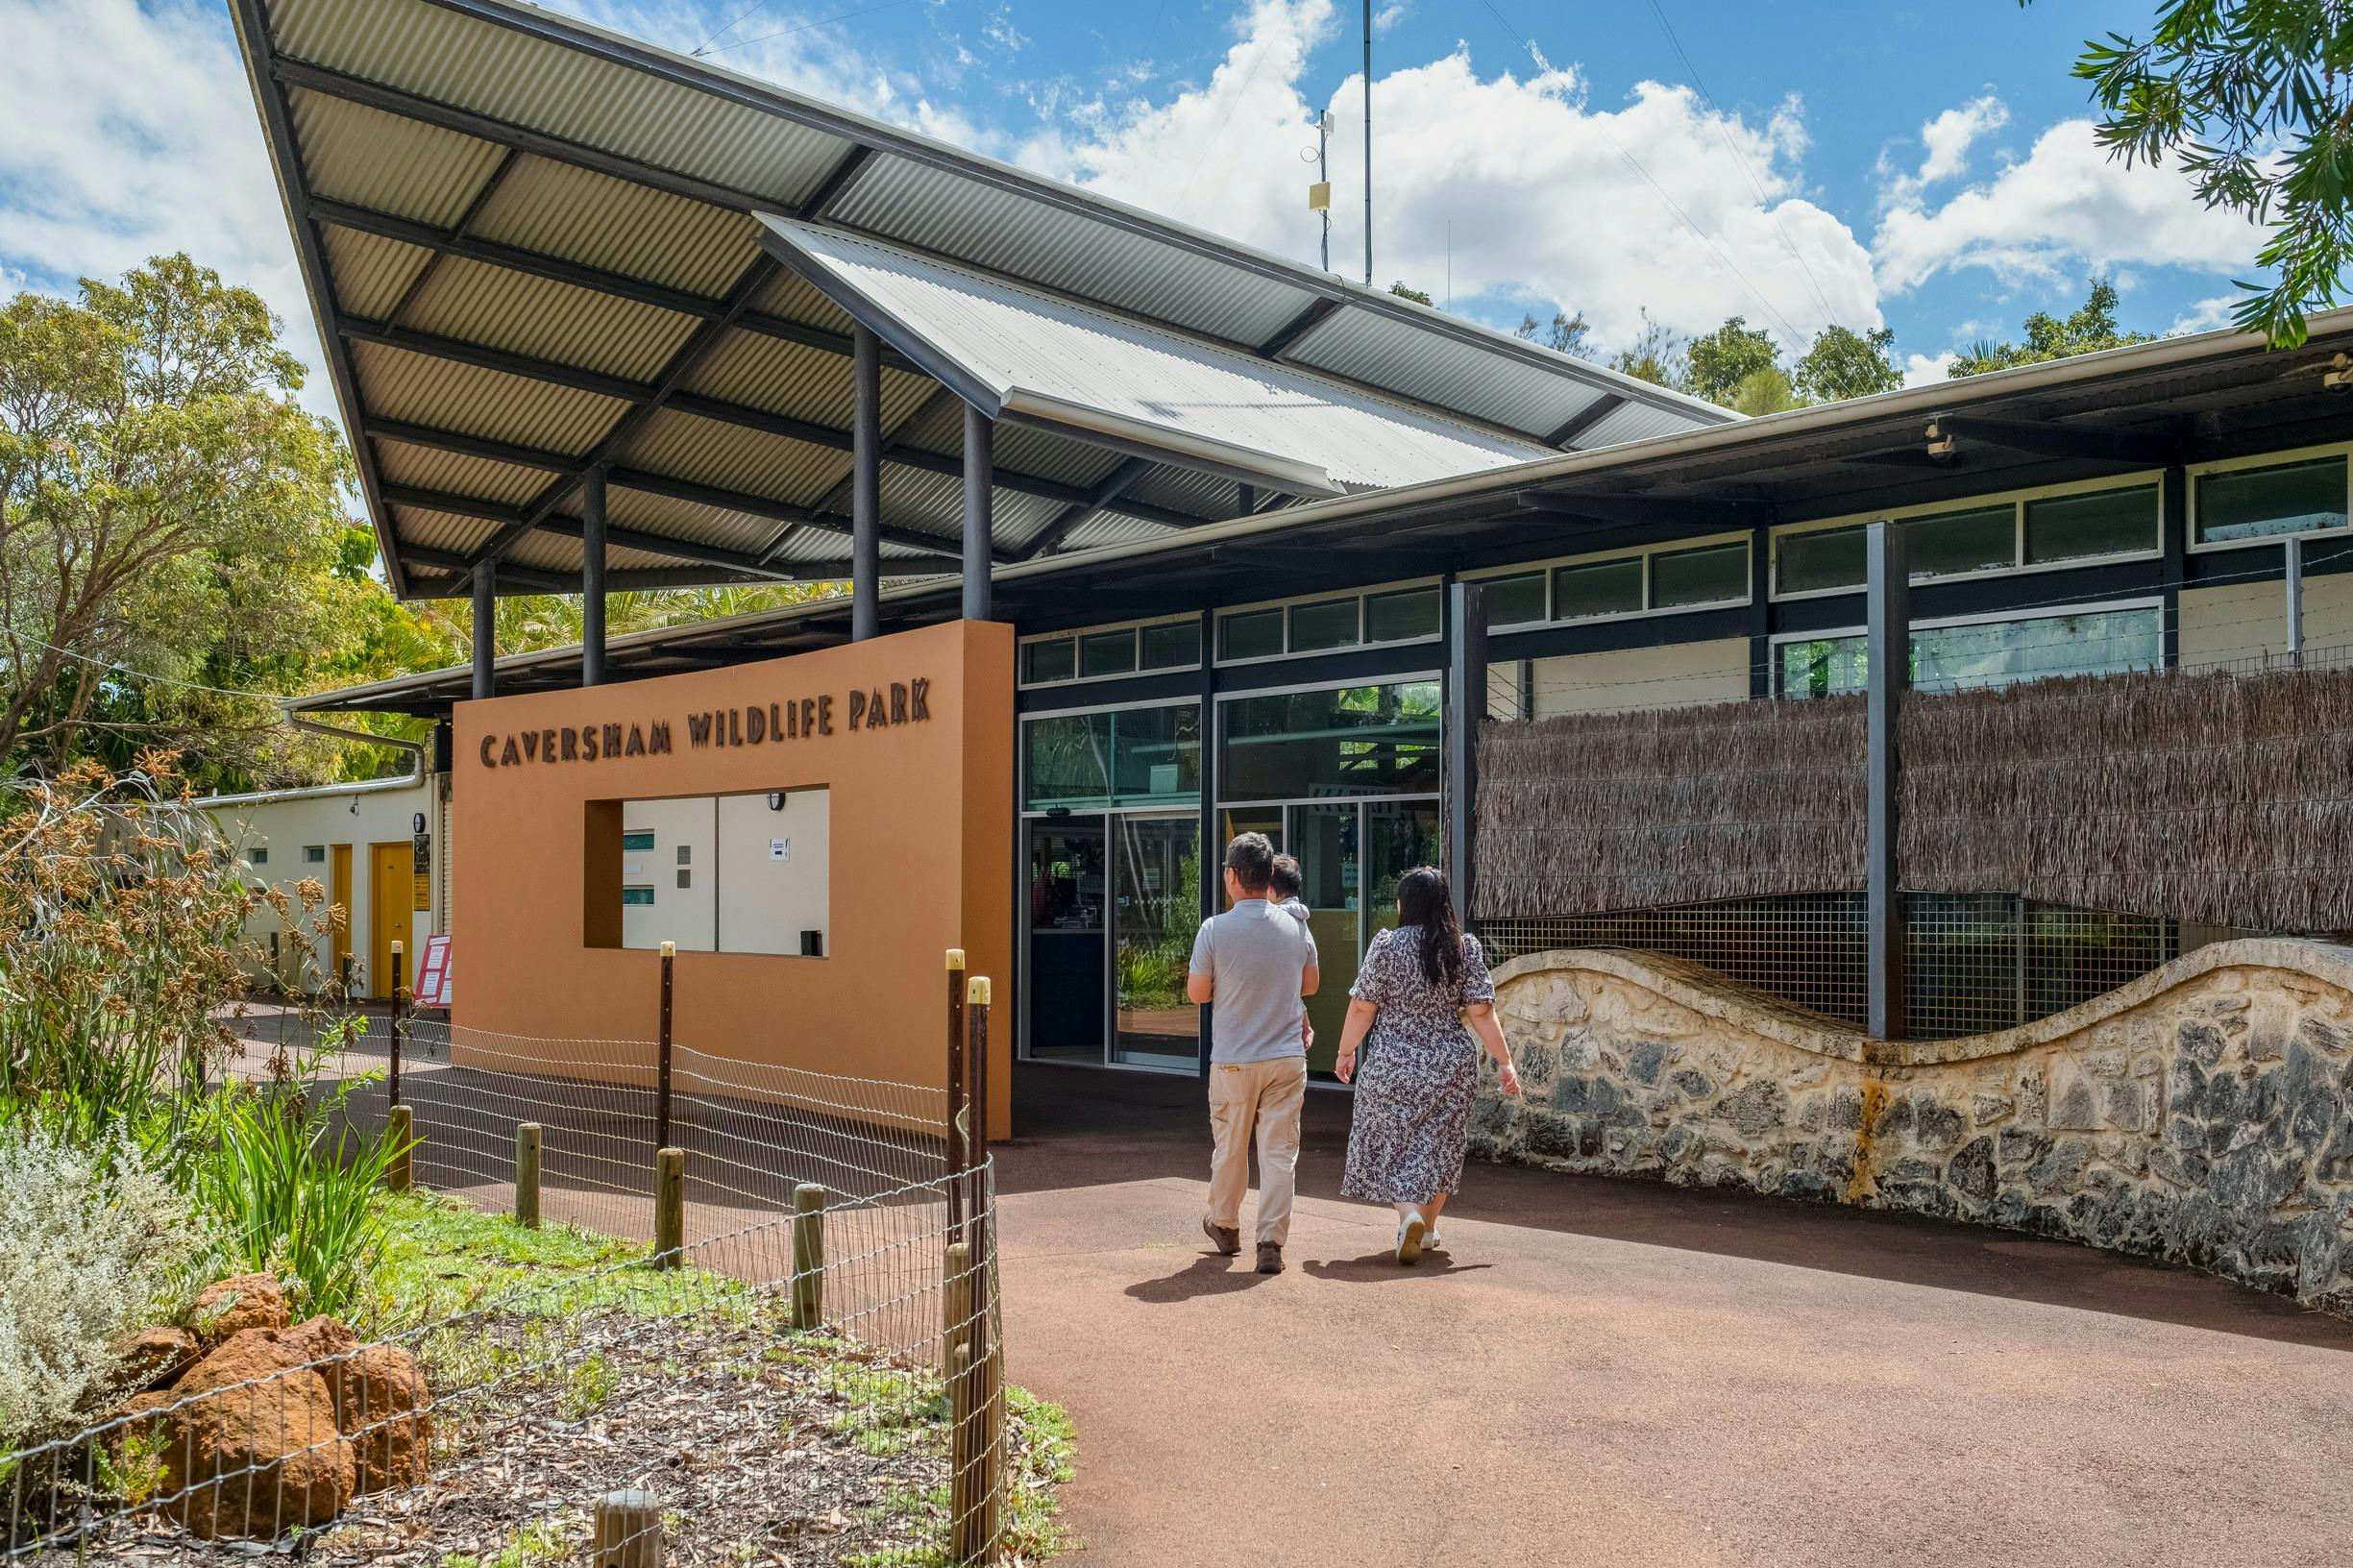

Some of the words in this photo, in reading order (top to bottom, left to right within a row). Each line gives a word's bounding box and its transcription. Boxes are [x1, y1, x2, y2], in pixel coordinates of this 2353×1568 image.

[479, 719, 672, 768] CAVERSHAM
[687, 695, 833, 747] WILDLIFE
[848, 676, 930, 731] PARK
